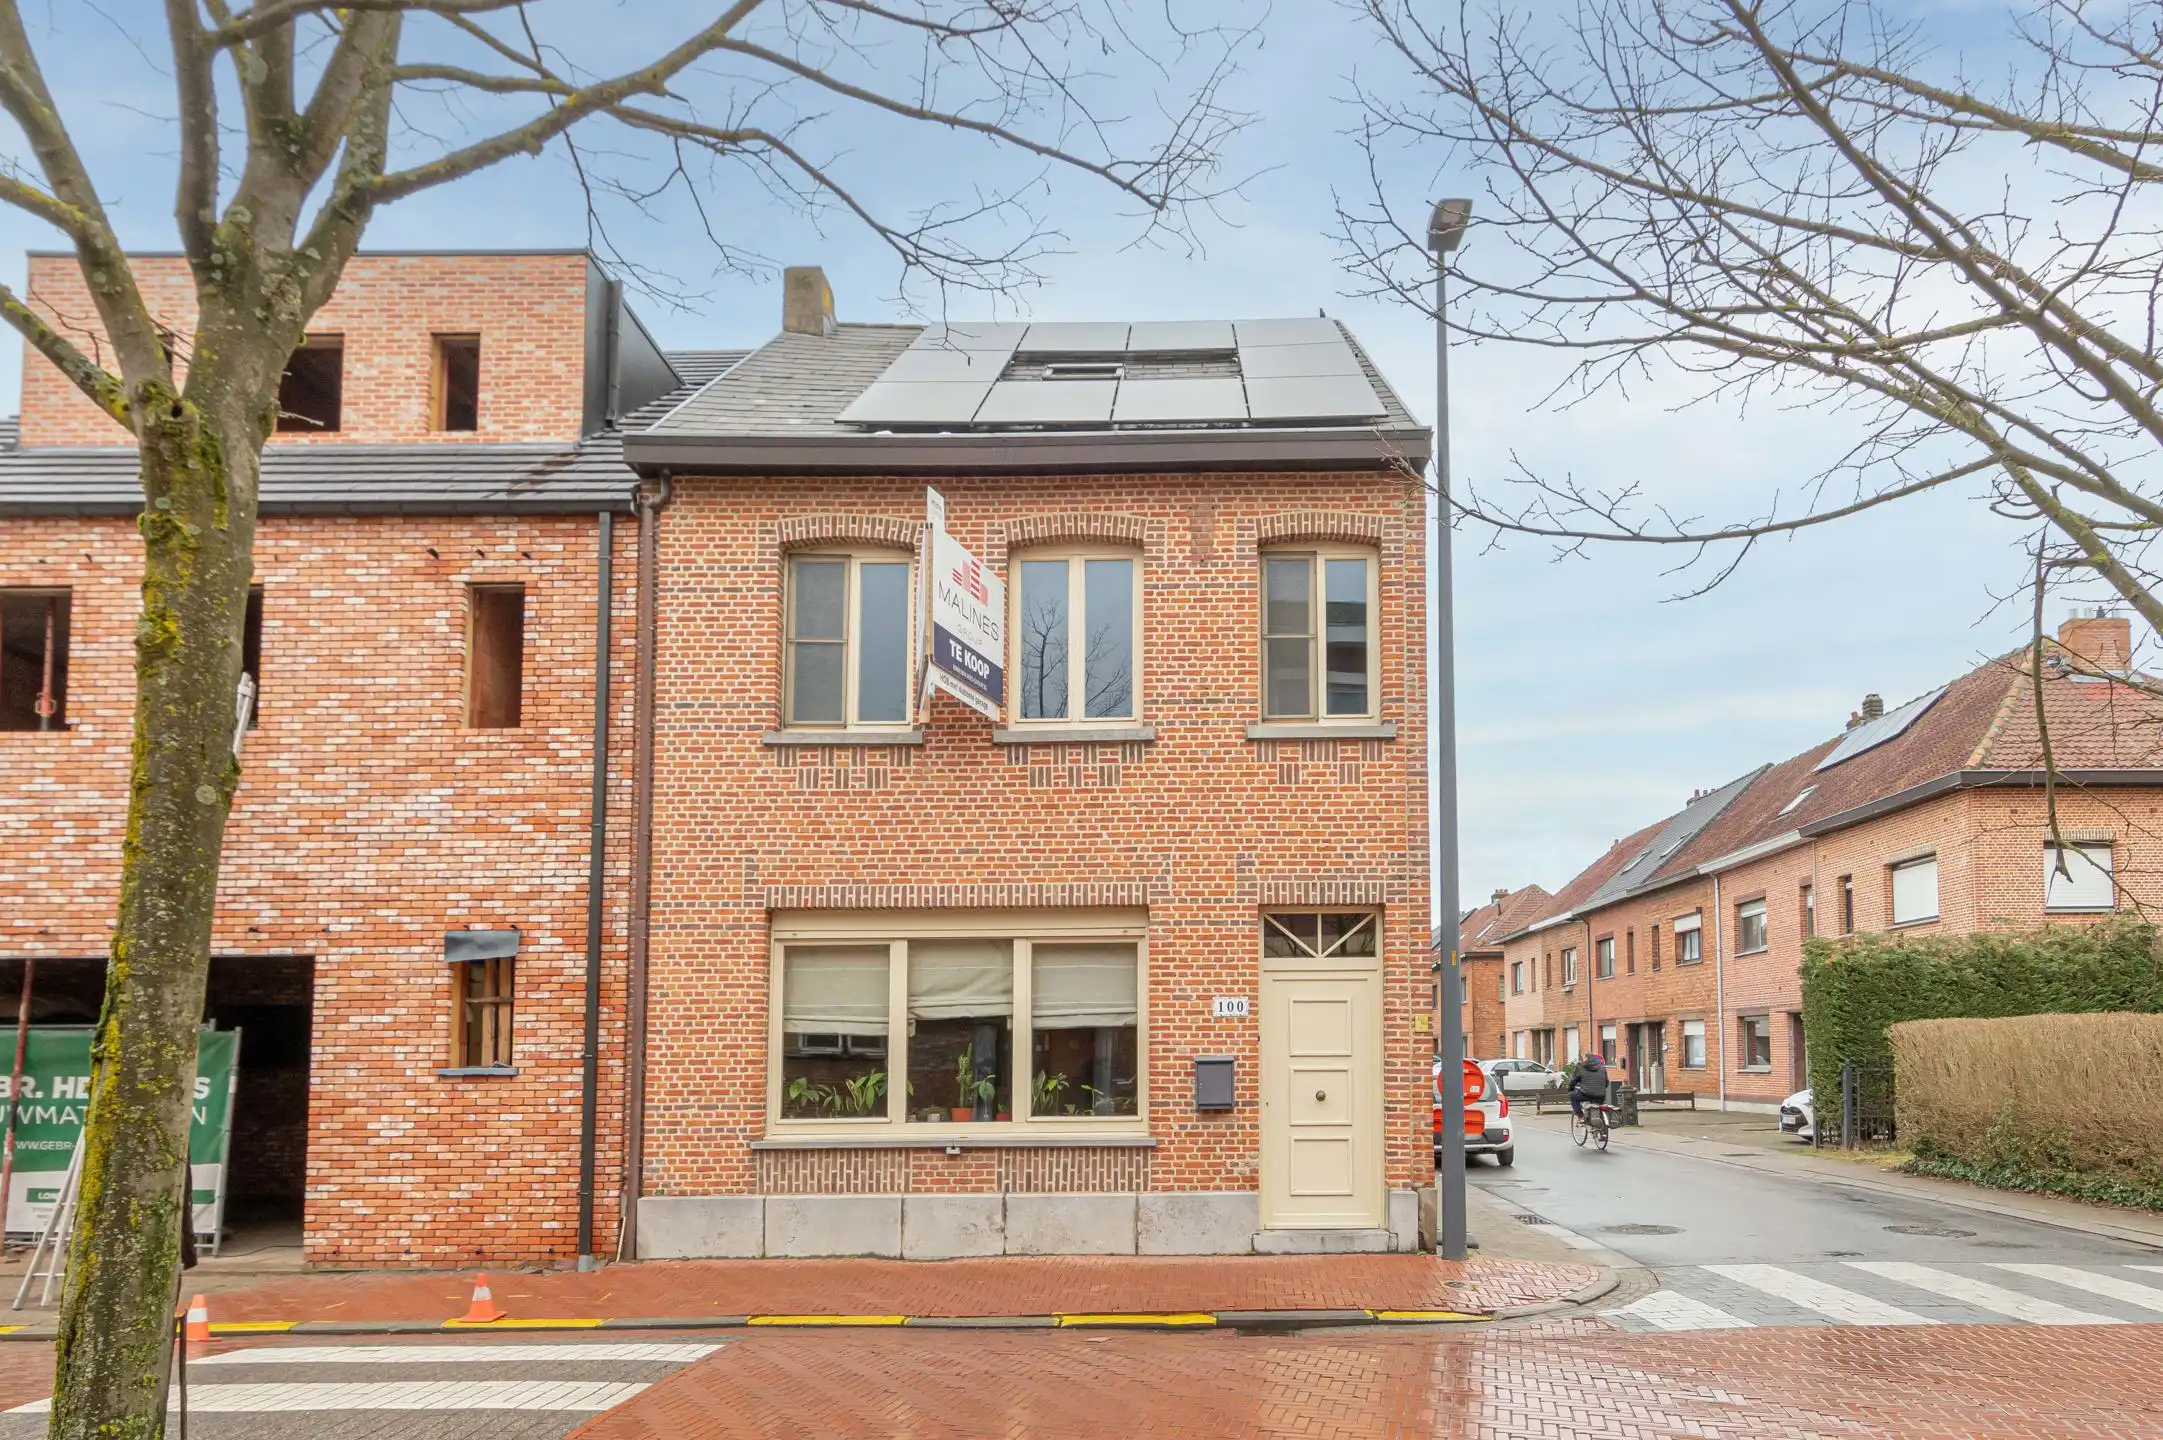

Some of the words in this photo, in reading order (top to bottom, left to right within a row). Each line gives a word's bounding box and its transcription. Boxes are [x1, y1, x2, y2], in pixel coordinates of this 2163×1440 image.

[939, 580, 999, 641] MALINES
[949, 638, 963, 663] TE
[964, 649, 990, 679] KOOP
[1219, 1001, 1244, 1012] 100
